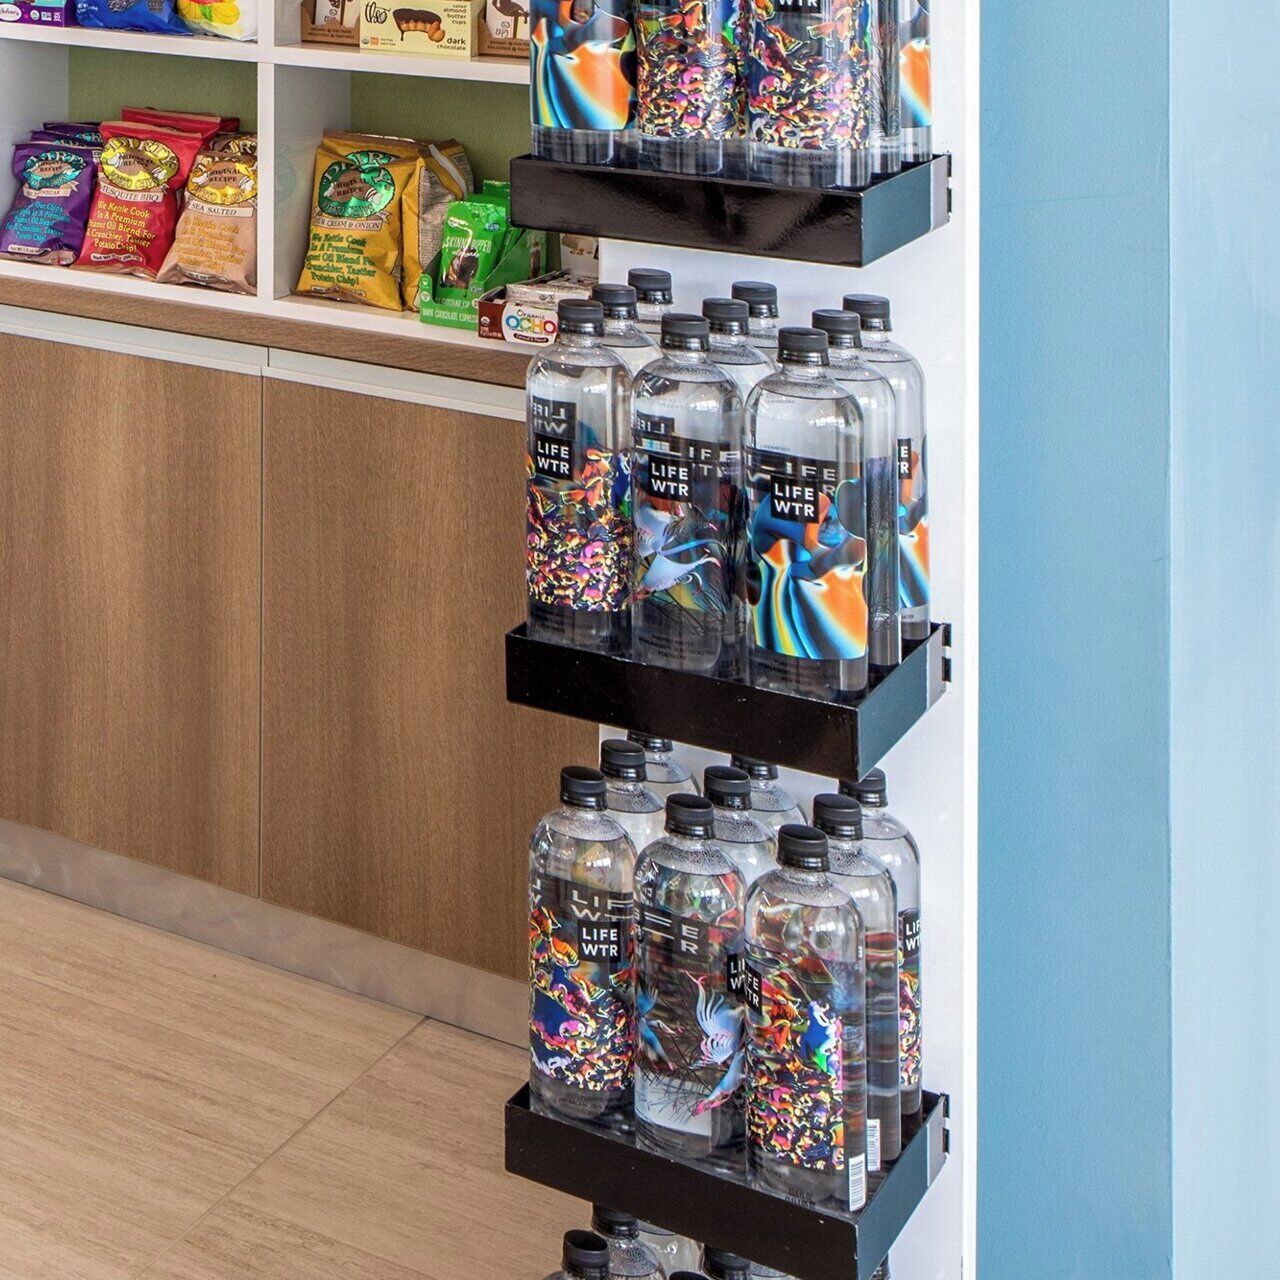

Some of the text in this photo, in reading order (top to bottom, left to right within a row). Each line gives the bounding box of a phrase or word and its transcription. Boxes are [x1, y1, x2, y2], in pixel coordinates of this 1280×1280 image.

[365, 2, 391, 24] theo
[447, 37, 466, 45] dark
[108, 138, 178, 172] DIRTY
[209, 175, 238, 183] RECIPE
[139, 193, 161, 203] BBQ
[108, 203, 150, 219] Kettle Cook
[191, 202, 237, 215] SEA SALTED
[110, 213, 145, 228] Premium
[326, 220, 380, 230] CREAM ONION
[106, 220, 156, 240] Oil Blend For
[94, 239, 116, 250] Potato
[127, 235, 151, 248] Tastier
[323, 234, 366, 247] Kettle Cook
[327, 244, 364, 255] Premium
[336, 253, 361, 266] Blend
[311, 270, 335, 282] Potato
[347, 266, 376, 277] Tastier
[517, 309, 545, 320] Organic
[506, 315, 556, 333] OCHO
[537, 440, 569, 459] LIFE
[537, 455, 569, 475] WTR
[651, 462, 688, 479] LIFE
[651, 480, 689, 497] WTR
[774, 483, 814, 500] LIFE
[774, 500, 814, 517] WTR
[582, 928, 618, 941] LIFE
[582, 943, 618, 956] WTR
